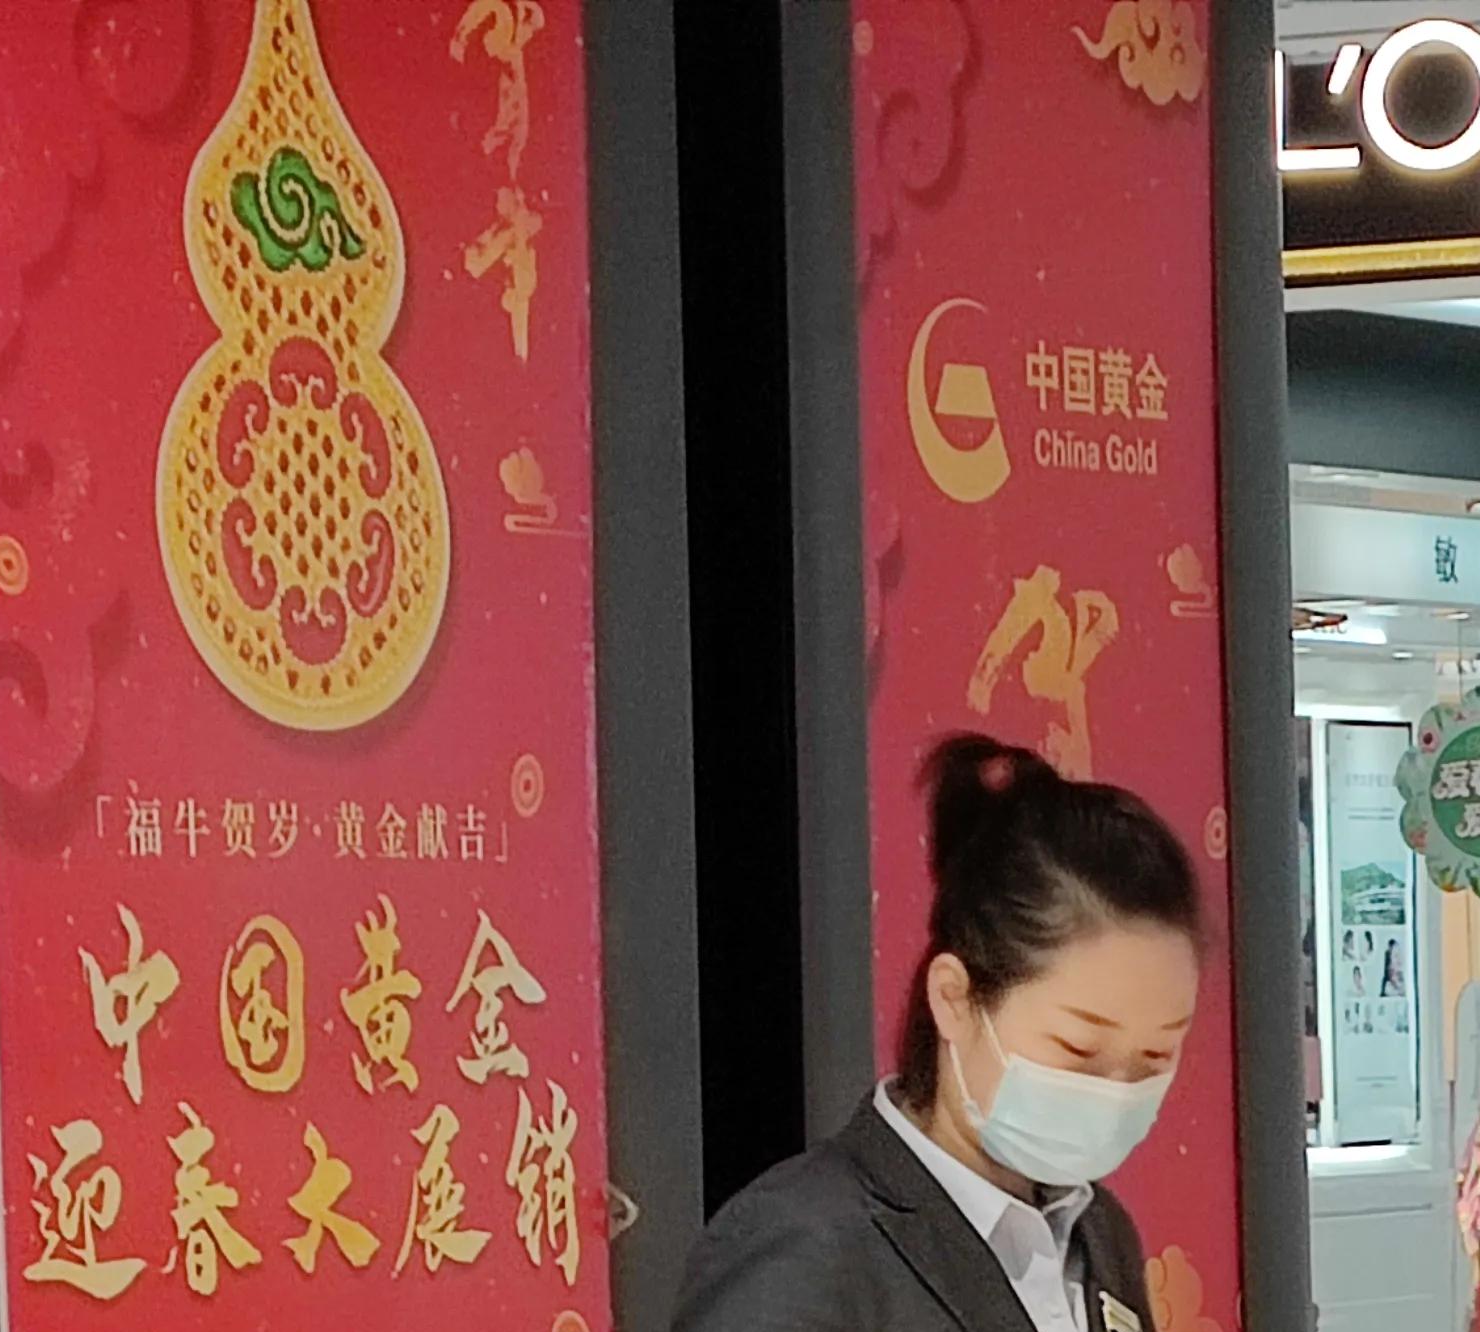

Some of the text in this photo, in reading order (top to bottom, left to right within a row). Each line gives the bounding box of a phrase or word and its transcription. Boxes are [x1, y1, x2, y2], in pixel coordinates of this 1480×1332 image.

[1024, 340, 1170, 422] 中国黄金
[1034, 426, 1159, 477] China Gold
[78, 891, 547, 1106] 中国黄金
[22, 1078, 580, 1301] 迎春大展销
